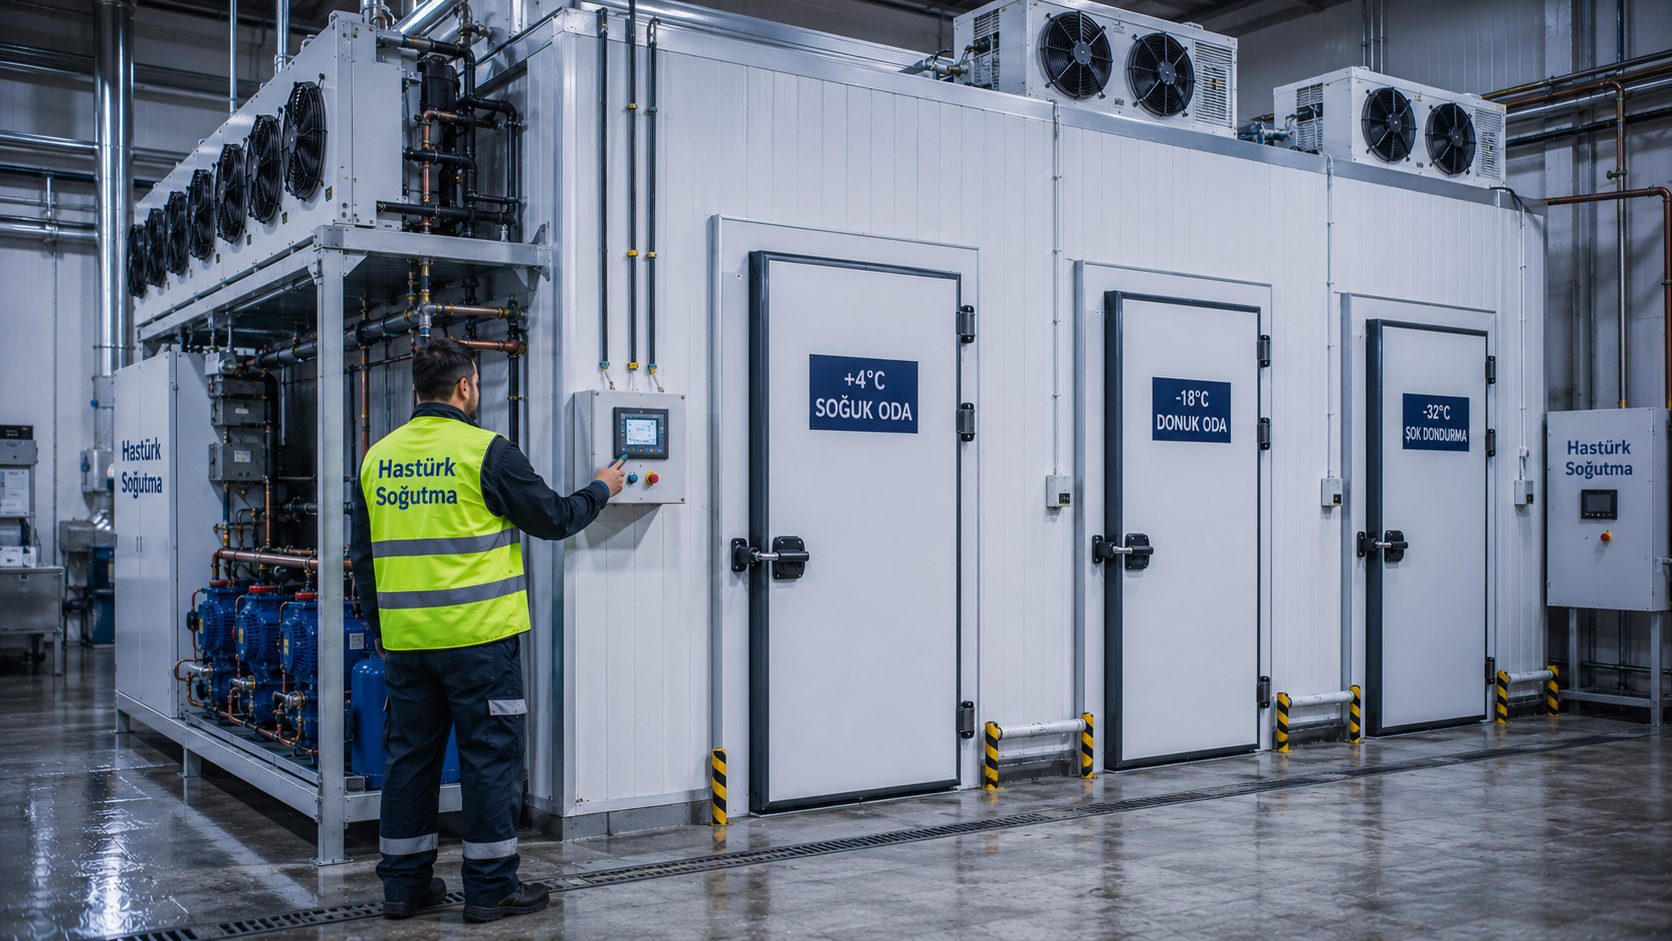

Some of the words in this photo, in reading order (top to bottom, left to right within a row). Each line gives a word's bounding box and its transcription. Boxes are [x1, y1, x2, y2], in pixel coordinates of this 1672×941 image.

[844, 369, 886, 391] +4°C
[815, 394, 874, 420] SOĞUK
[878, 401, 913, 421] ODA
[1175, 389, 1209, 408] -18°C
[1423, 404, 1451, 420] -32°C
[1157, 413, 1200, 432] DONUK
[1202, 416, 1227, 433] ODA
[1405, 426, 1422, 443] ŞOK
[1423, 427, 1468, 443] DONDURMA
[122, 436, 161, 462] Hastürk
[1567, 439, 1632, 456] Hastürk
[378, 456, 457, 479] Hastürk
[1565, 460, 1634, 480] Soğutma
[121, 470, 163, 499] Soğutma
[375, 485, 458, 511] Soğutma
